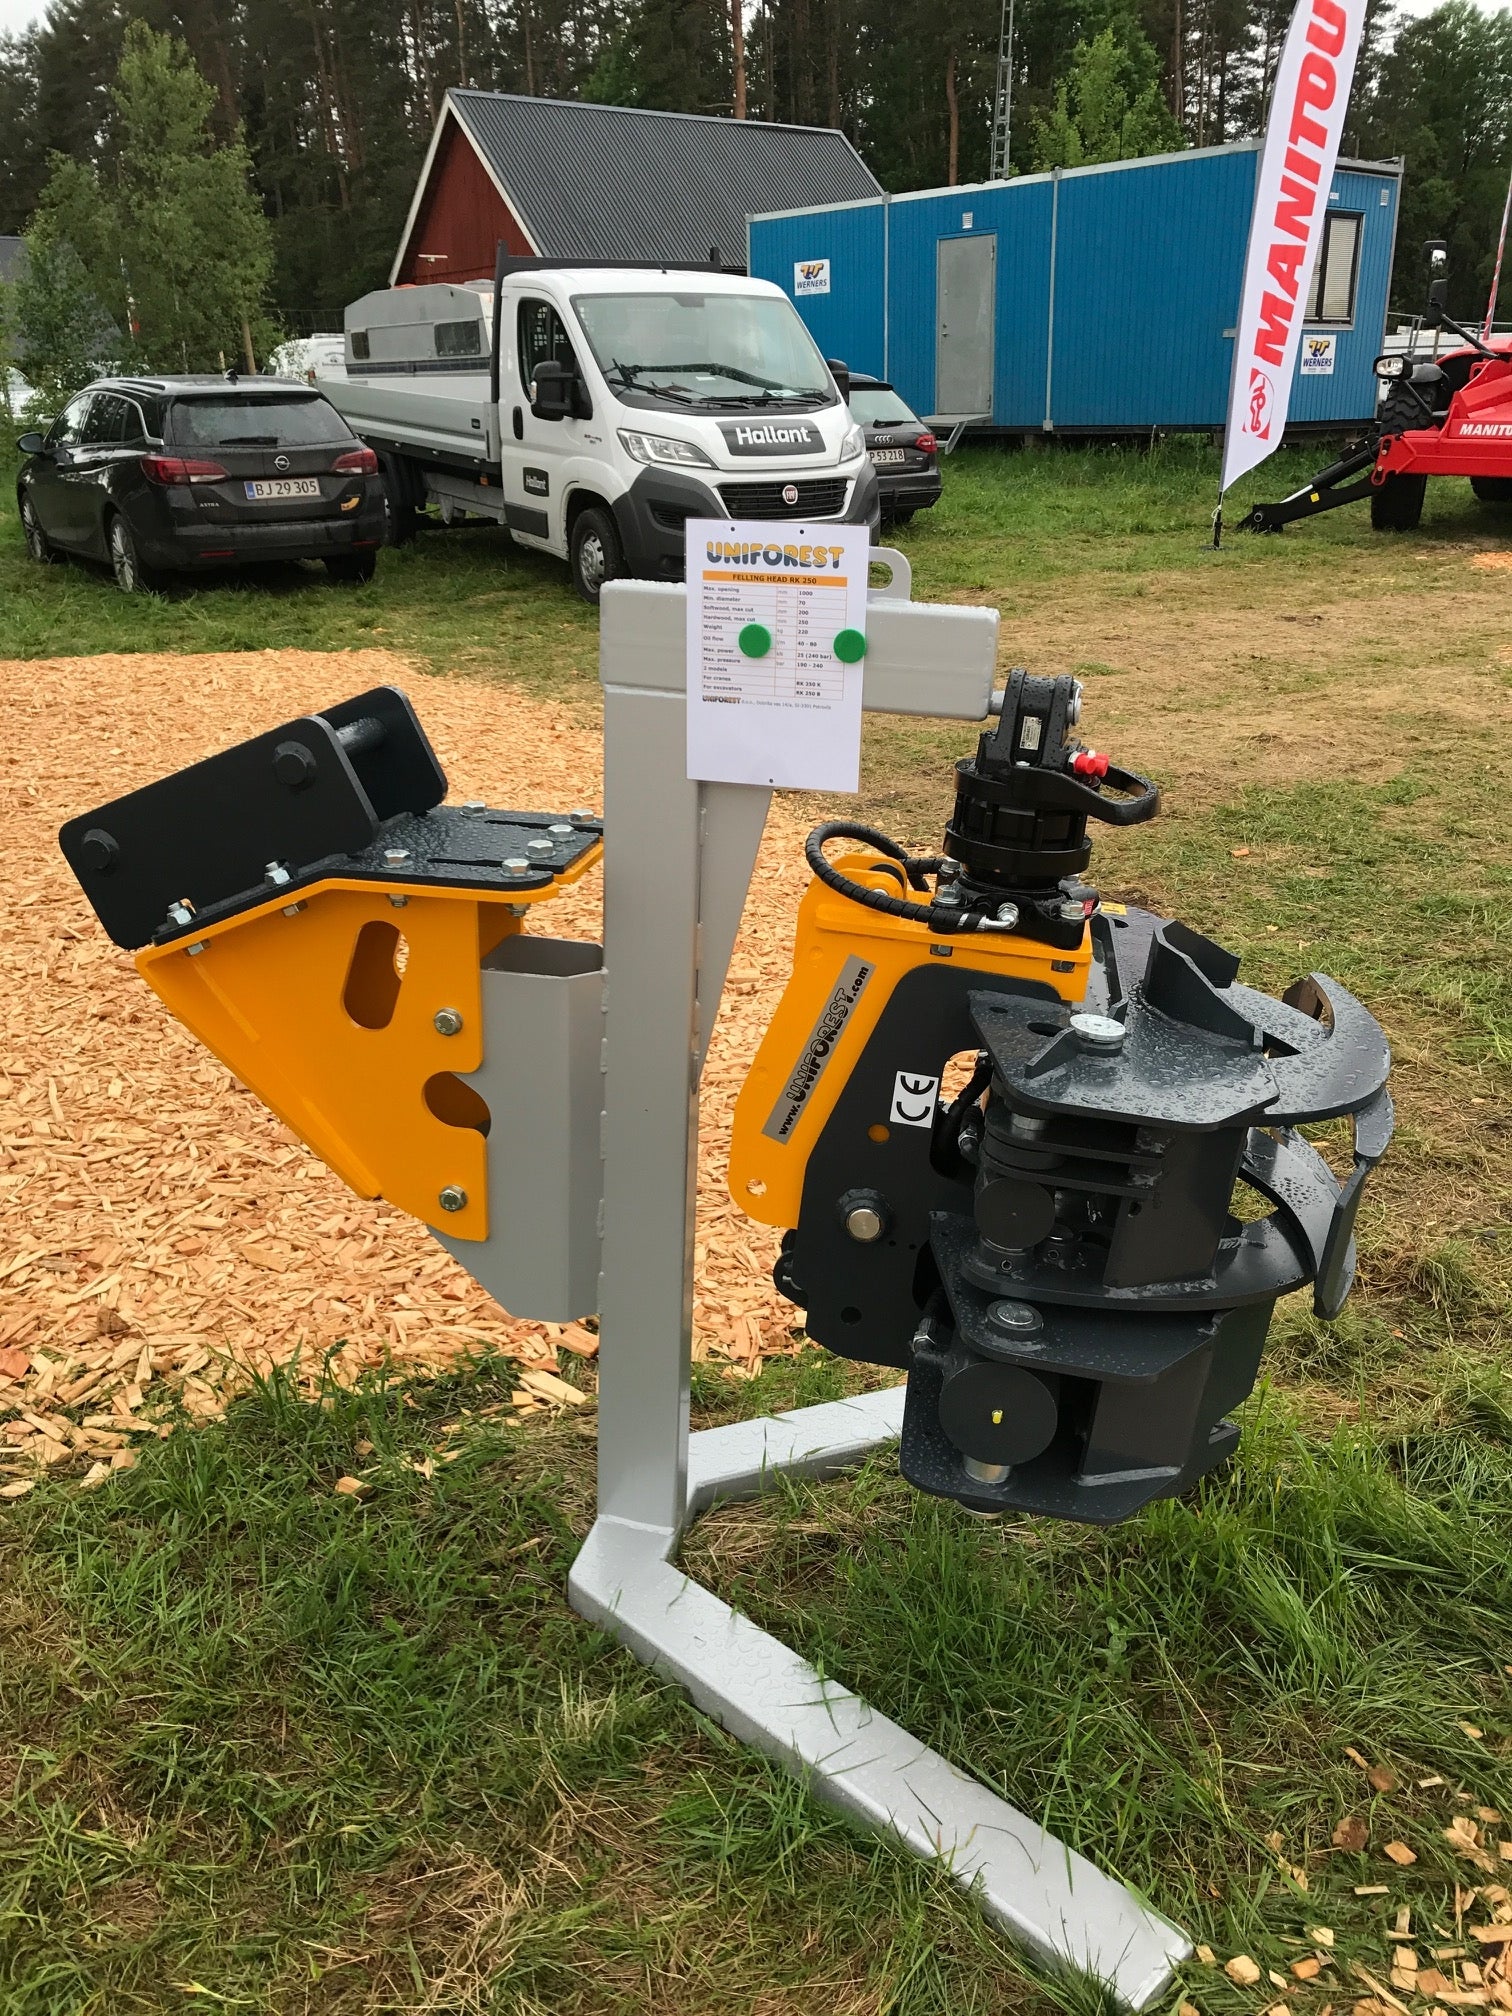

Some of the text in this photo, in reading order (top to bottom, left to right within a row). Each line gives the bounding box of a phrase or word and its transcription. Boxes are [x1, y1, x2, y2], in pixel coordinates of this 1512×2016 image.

[1253, 0, 1347, 367] MANITOU
[796, 279, 828, 289] WERNERS
[1303, 358, 1333, 367] WERNERS
[735, 425, 812, 445] Hallant
[877, 450, 887, 461] 53
[888, 449, 904, 460] 218
[255, 480, 317, 497] BJ 29 305
[706, 541, 845, 569] UNIFOREST
[732, 573, 817, 585] FELLING HEAD RK 250
[702, 695, 741, 704] UNIFOREST
